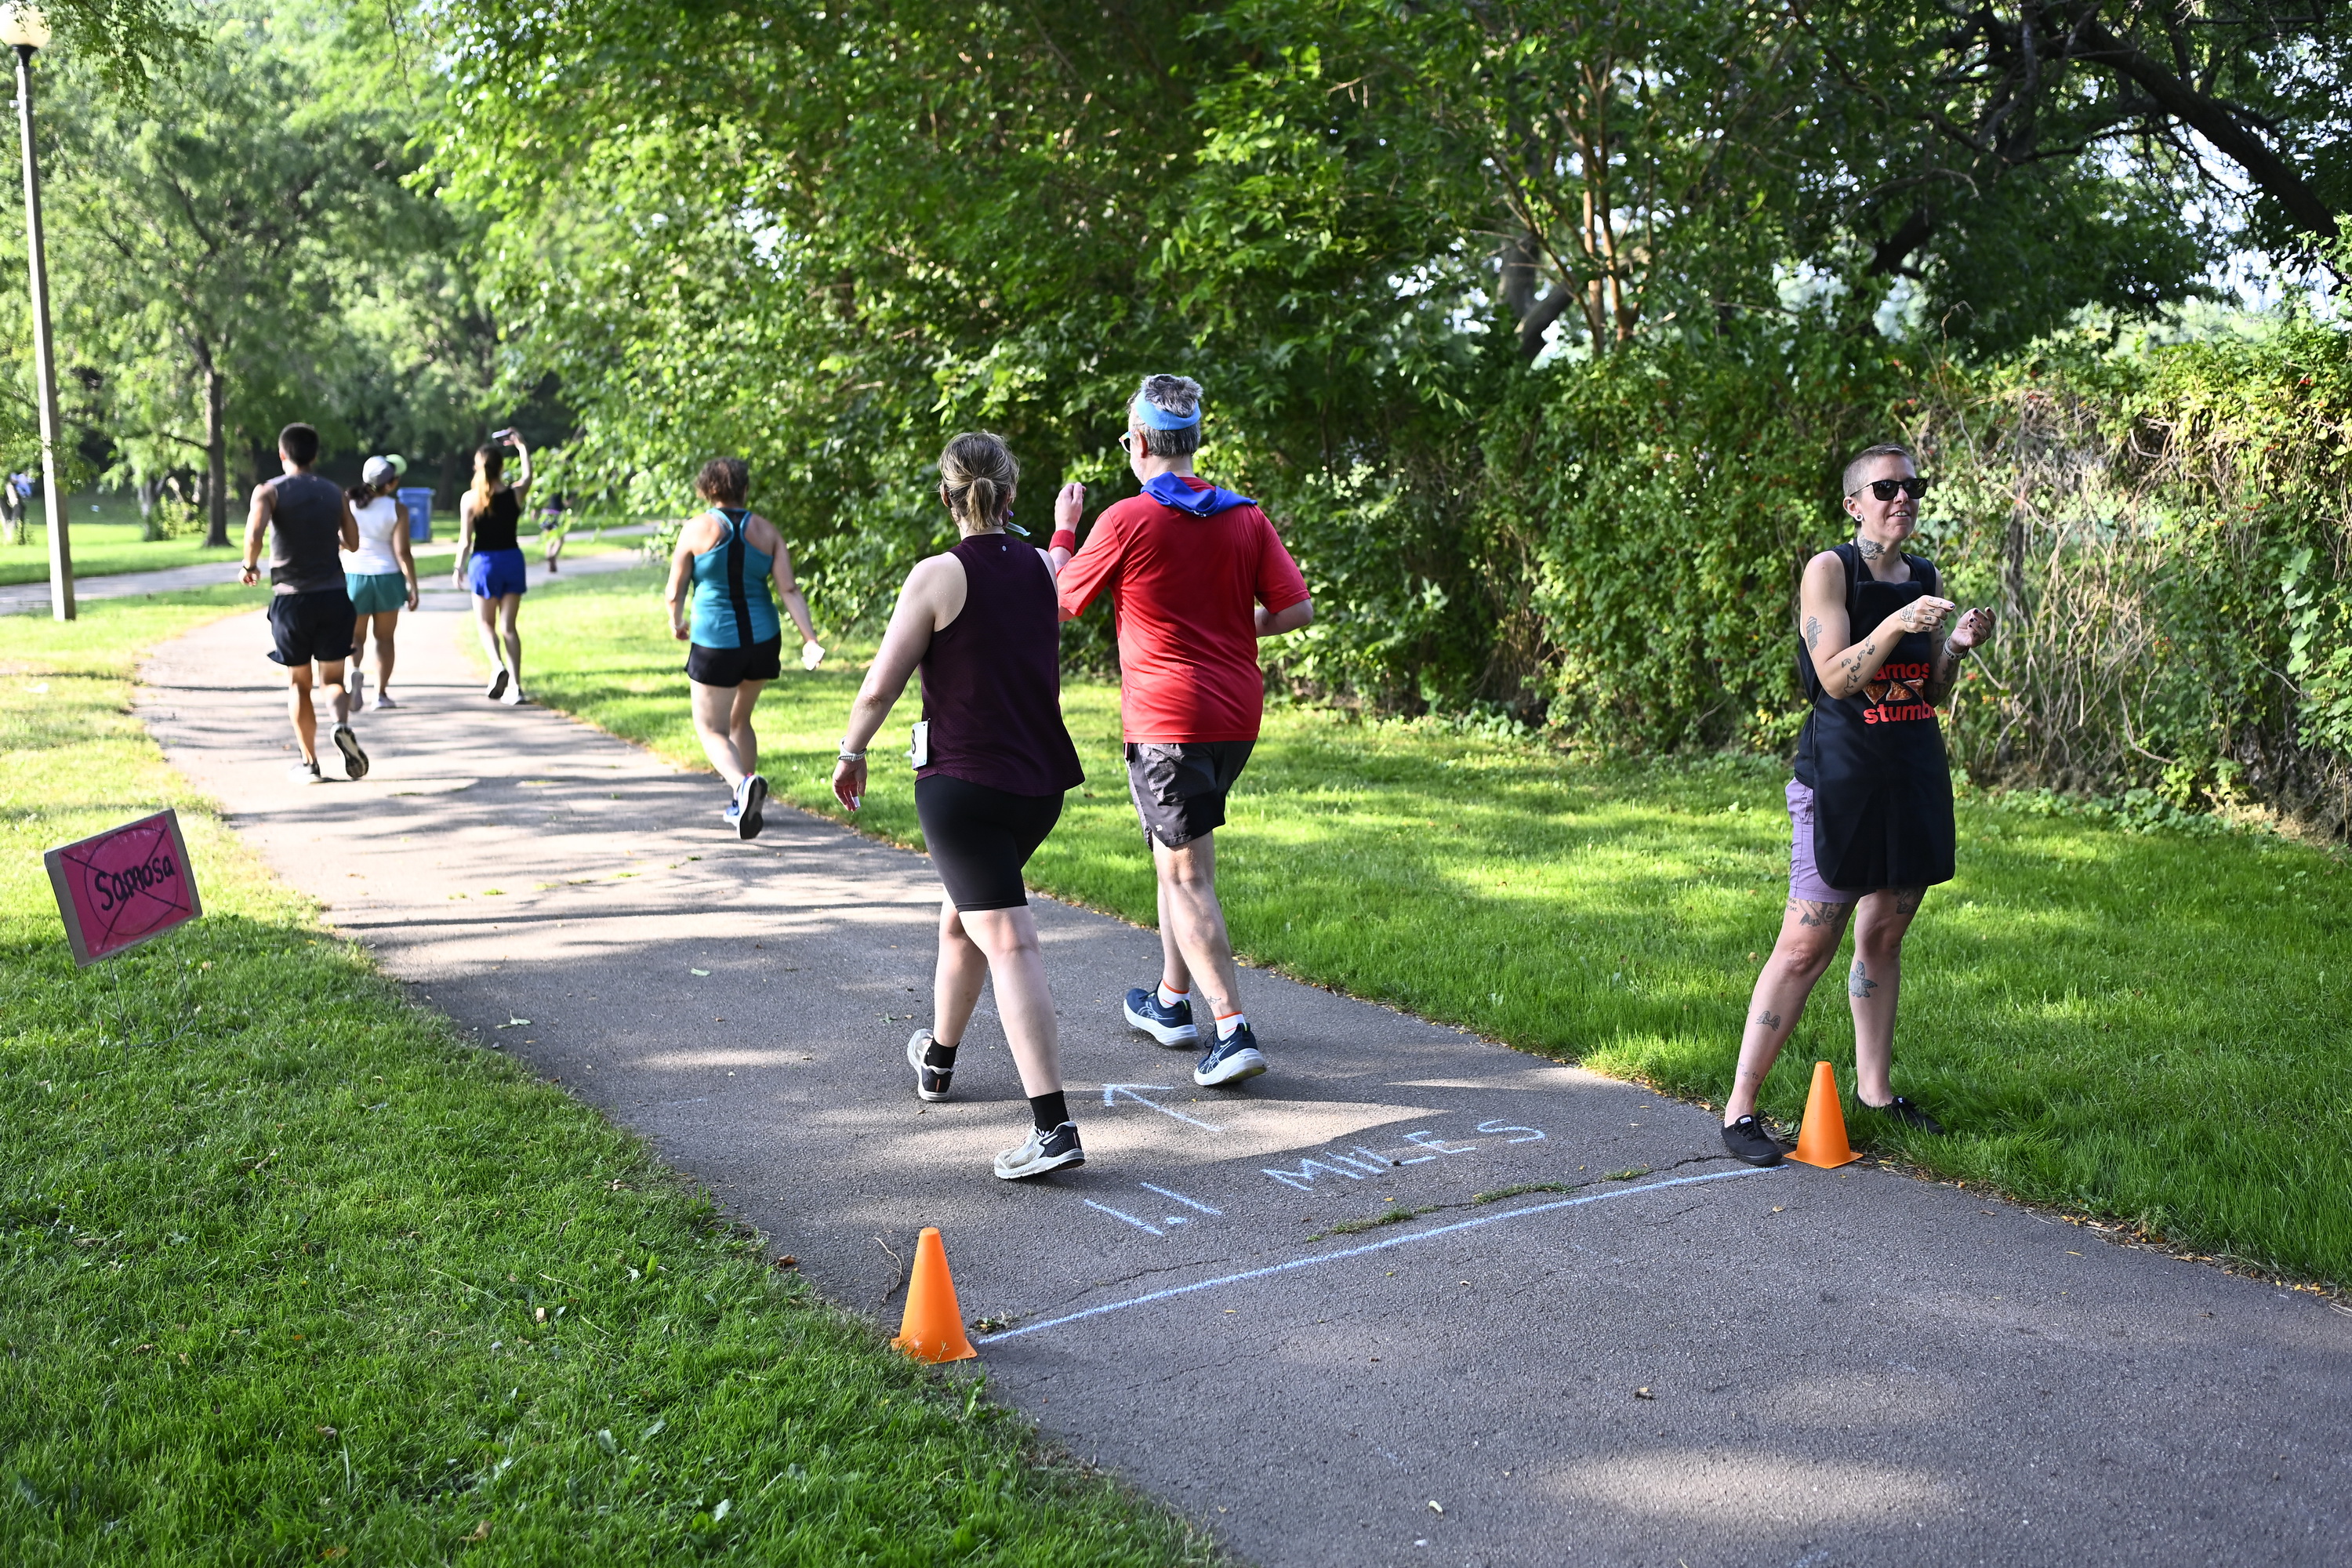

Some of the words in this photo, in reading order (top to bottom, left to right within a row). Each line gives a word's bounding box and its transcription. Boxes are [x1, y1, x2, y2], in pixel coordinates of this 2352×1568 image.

[1873, 662, 1930, 681] amos
[95, 855, 176, 911] Samosa
[1261, 1119, 1546, 1192] MILES
